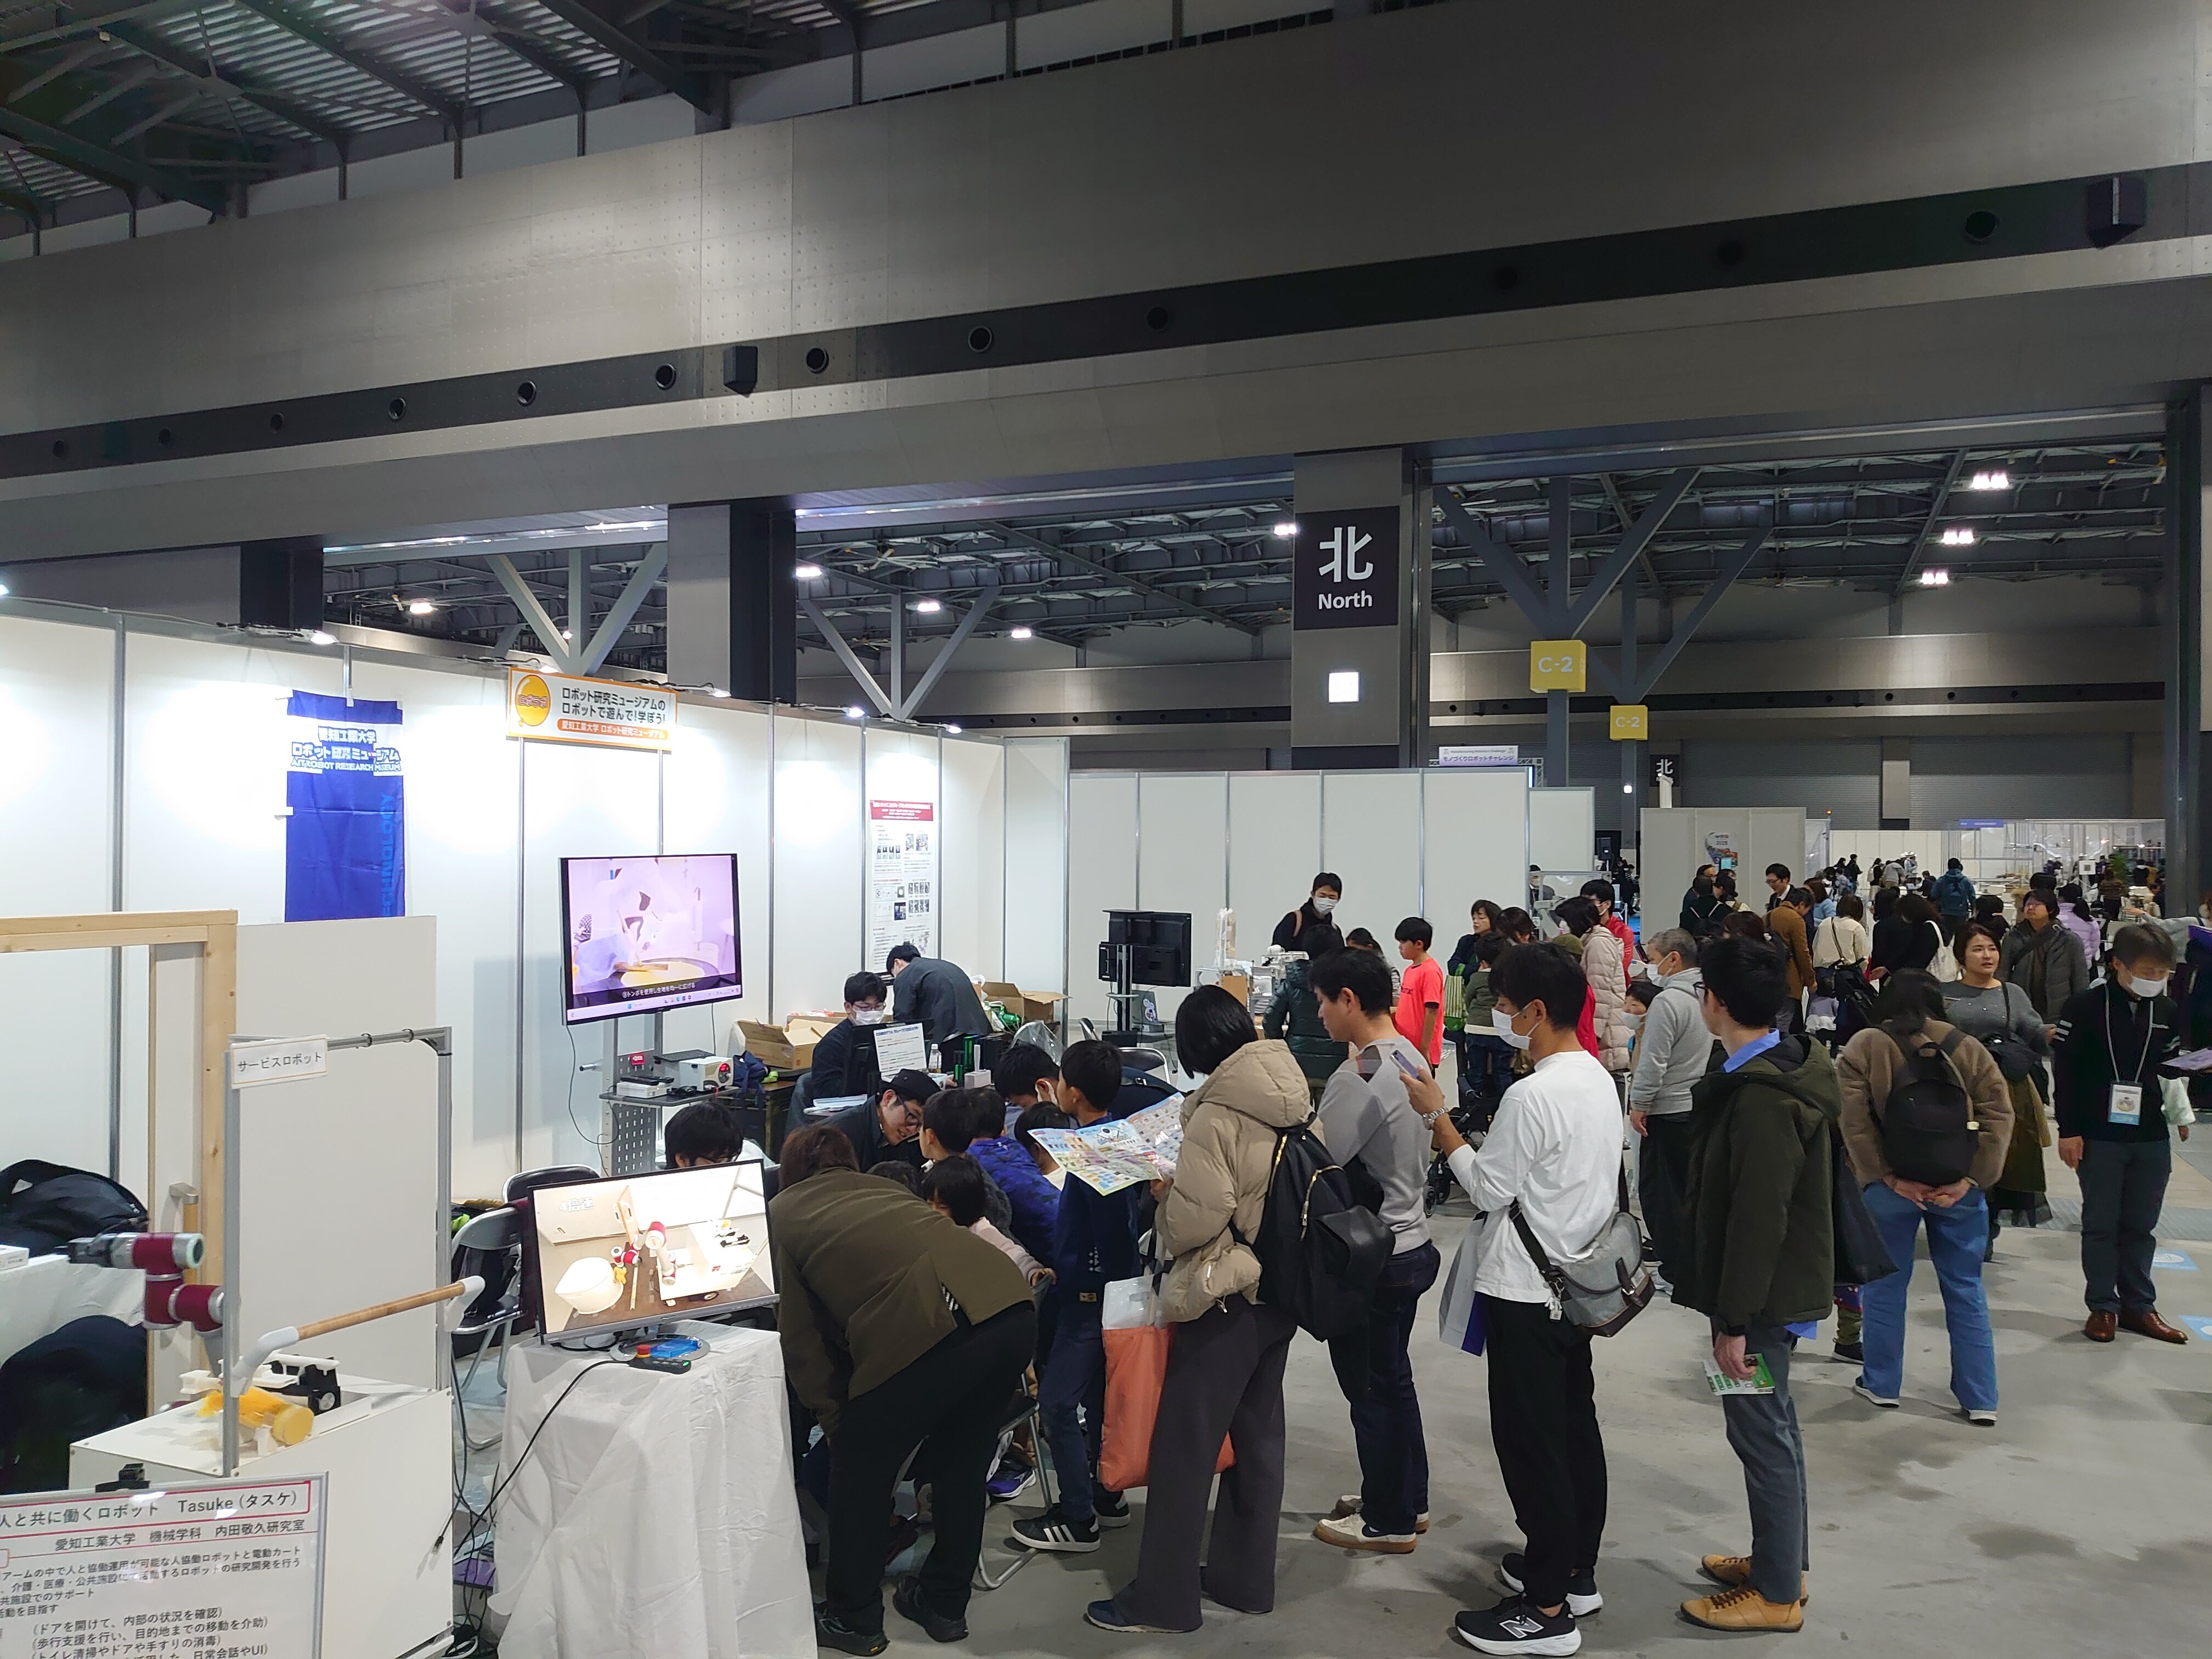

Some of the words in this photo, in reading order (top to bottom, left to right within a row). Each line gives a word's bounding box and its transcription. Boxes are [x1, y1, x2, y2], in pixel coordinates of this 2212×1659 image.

[1318, 526, 1374, 583] 北
[1318, 590, 1373, 610] North
[1538, 656, 1573, 673] C-2
[562, 687, 666, 712] ロボット研究ミュージアムの
[562, 720, 599, 732] 愛知工業大学
[601, 725, 665, 740] ロボット研究ミュージアム
[1615, 716, 1640, 727] C-2
[335, 761, 374, 771] RESEARCH
[1656, 759, 1673, 775] 北
[238, 1052, 322, 1072] サービスロボット
[0, 1502, 159, 1528] 人と共に働くロボット
[55, 1533, 136, 1551] 愛知工業大学
[150, 1527, 201, 1543] 機械学科
